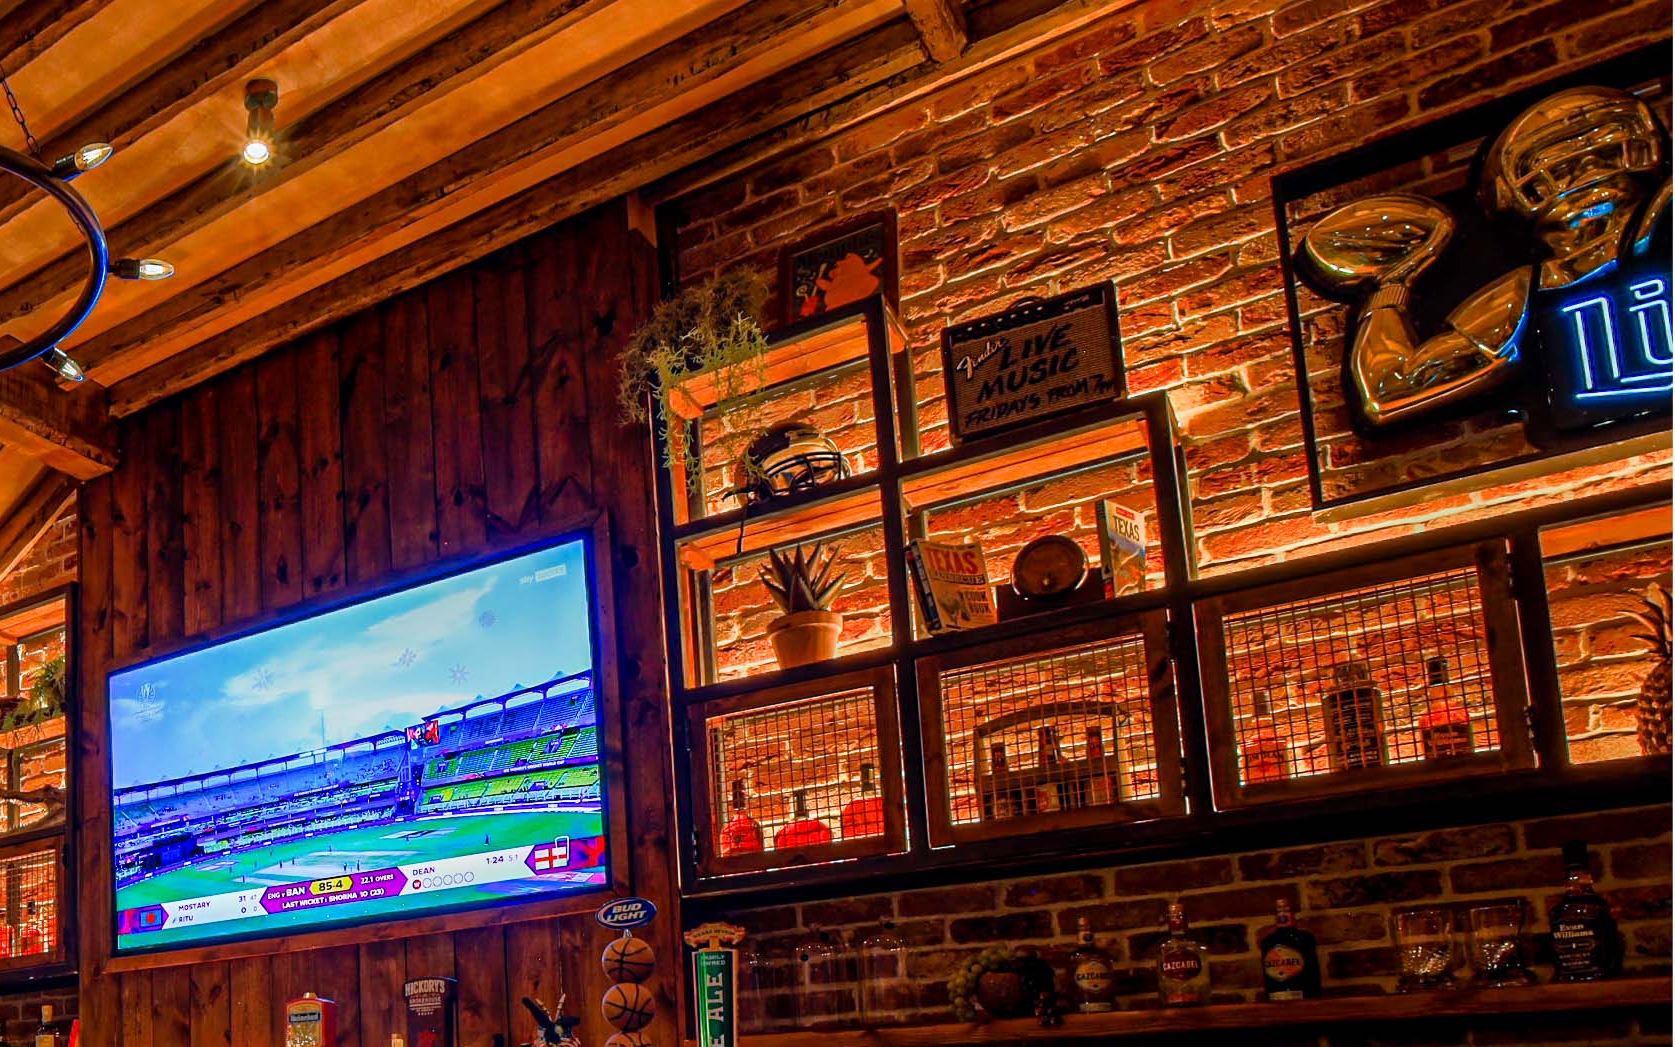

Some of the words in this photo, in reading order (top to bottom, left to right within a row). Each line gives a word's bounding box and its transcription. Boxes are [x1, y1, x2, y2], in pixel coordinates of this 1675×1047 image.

[999, 323, 1072, 371] LIVE
[956, 337, 1010, 380] Fender
[977, 348, 1080, 404] MUSIC
[964, 393, 1043, 428] FRIDAYS
[1046, 378, 1088, 403] FROM
[1112, 515, 1141, 542] TEXAS
[928, 549, 979, 575] TEXAS
[412, 866, 436, 877] DEAN
[267, 891, 280, 901] ENG
[286, 886, 306, 898] BAN
[318, 880, 344, 892] 85-4
[361, 876, 374, 885] 22.1
[375, 874, 394, 882] OVERS
[178, 901, 211, 912] MOSTARY
[238, 895, 247, 903] 31
[282, 901, 299, 910] LAST
[360, 890, 369, 899] 10
[611, 903, 642, 914] BUD
[178, 915, 194, 923] RITU
[606, 910, 647, 924] LIGHT
[1552, 930, 1595, 939] Williams
[1559, 923, 1585, 932] Evan
[707, 972, 724, 1022] ALE
